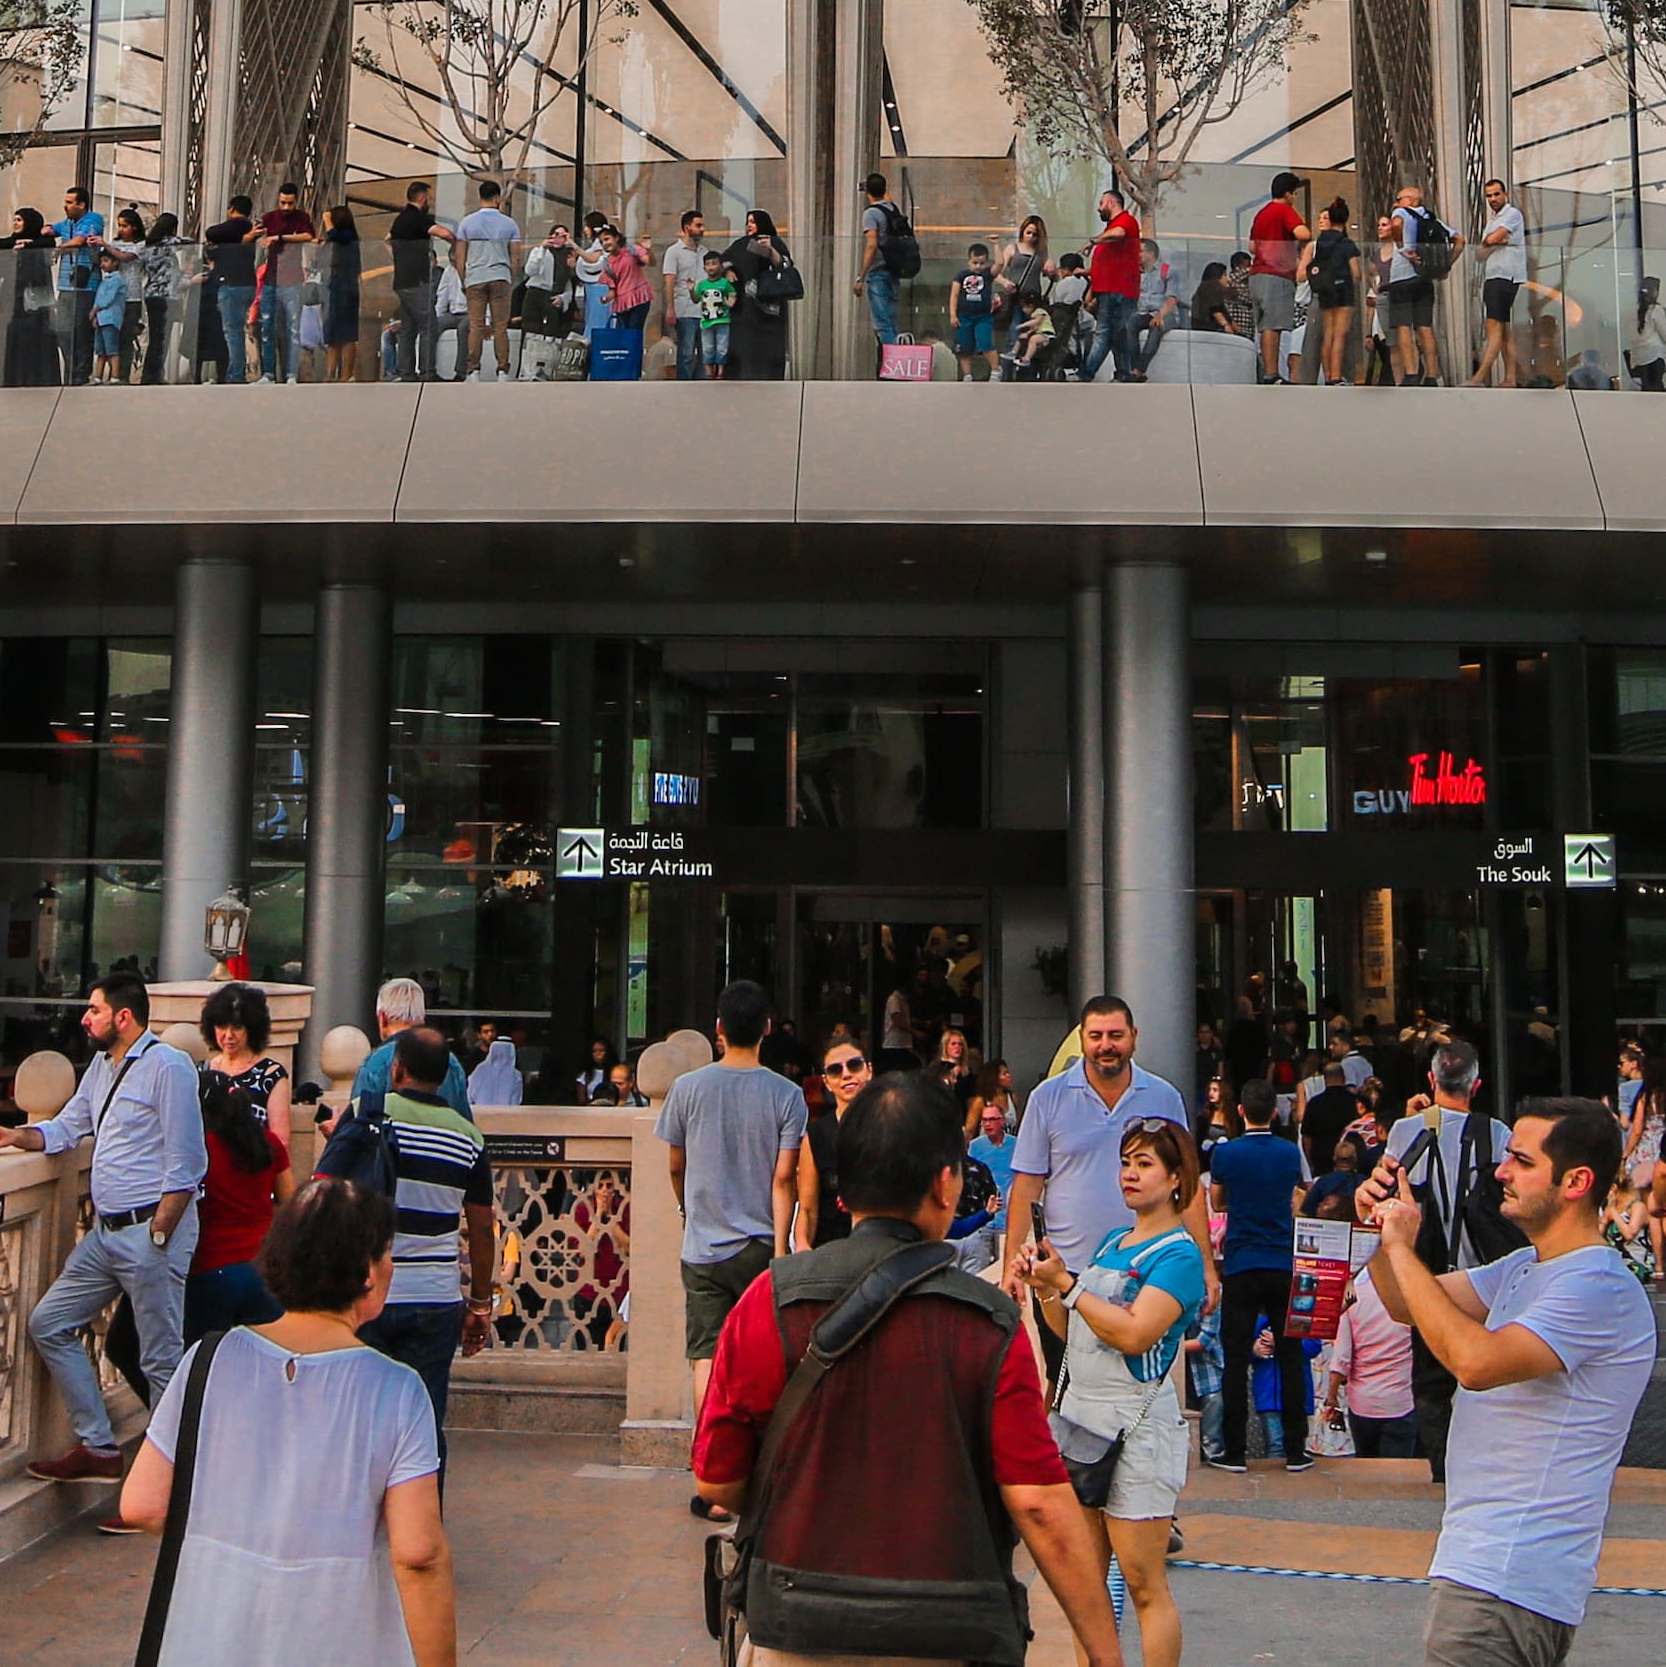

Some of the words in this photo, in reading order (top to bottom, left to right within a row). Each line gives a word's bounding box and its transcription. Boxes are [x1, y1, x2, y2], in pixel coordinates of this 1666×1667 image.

[883, 358, 928, 377] SALE
[609, 831, 648, 854] النجمة
[651, 832, 684, 850] قاعة
[1493, 837, 1533, 860] السوق
[609, 858, 646, 876] Star
[649, 858, 713, 877] Atrium
[1476, 865, 1508, 882] The
[1511, 865, 1552, 882] Souk
